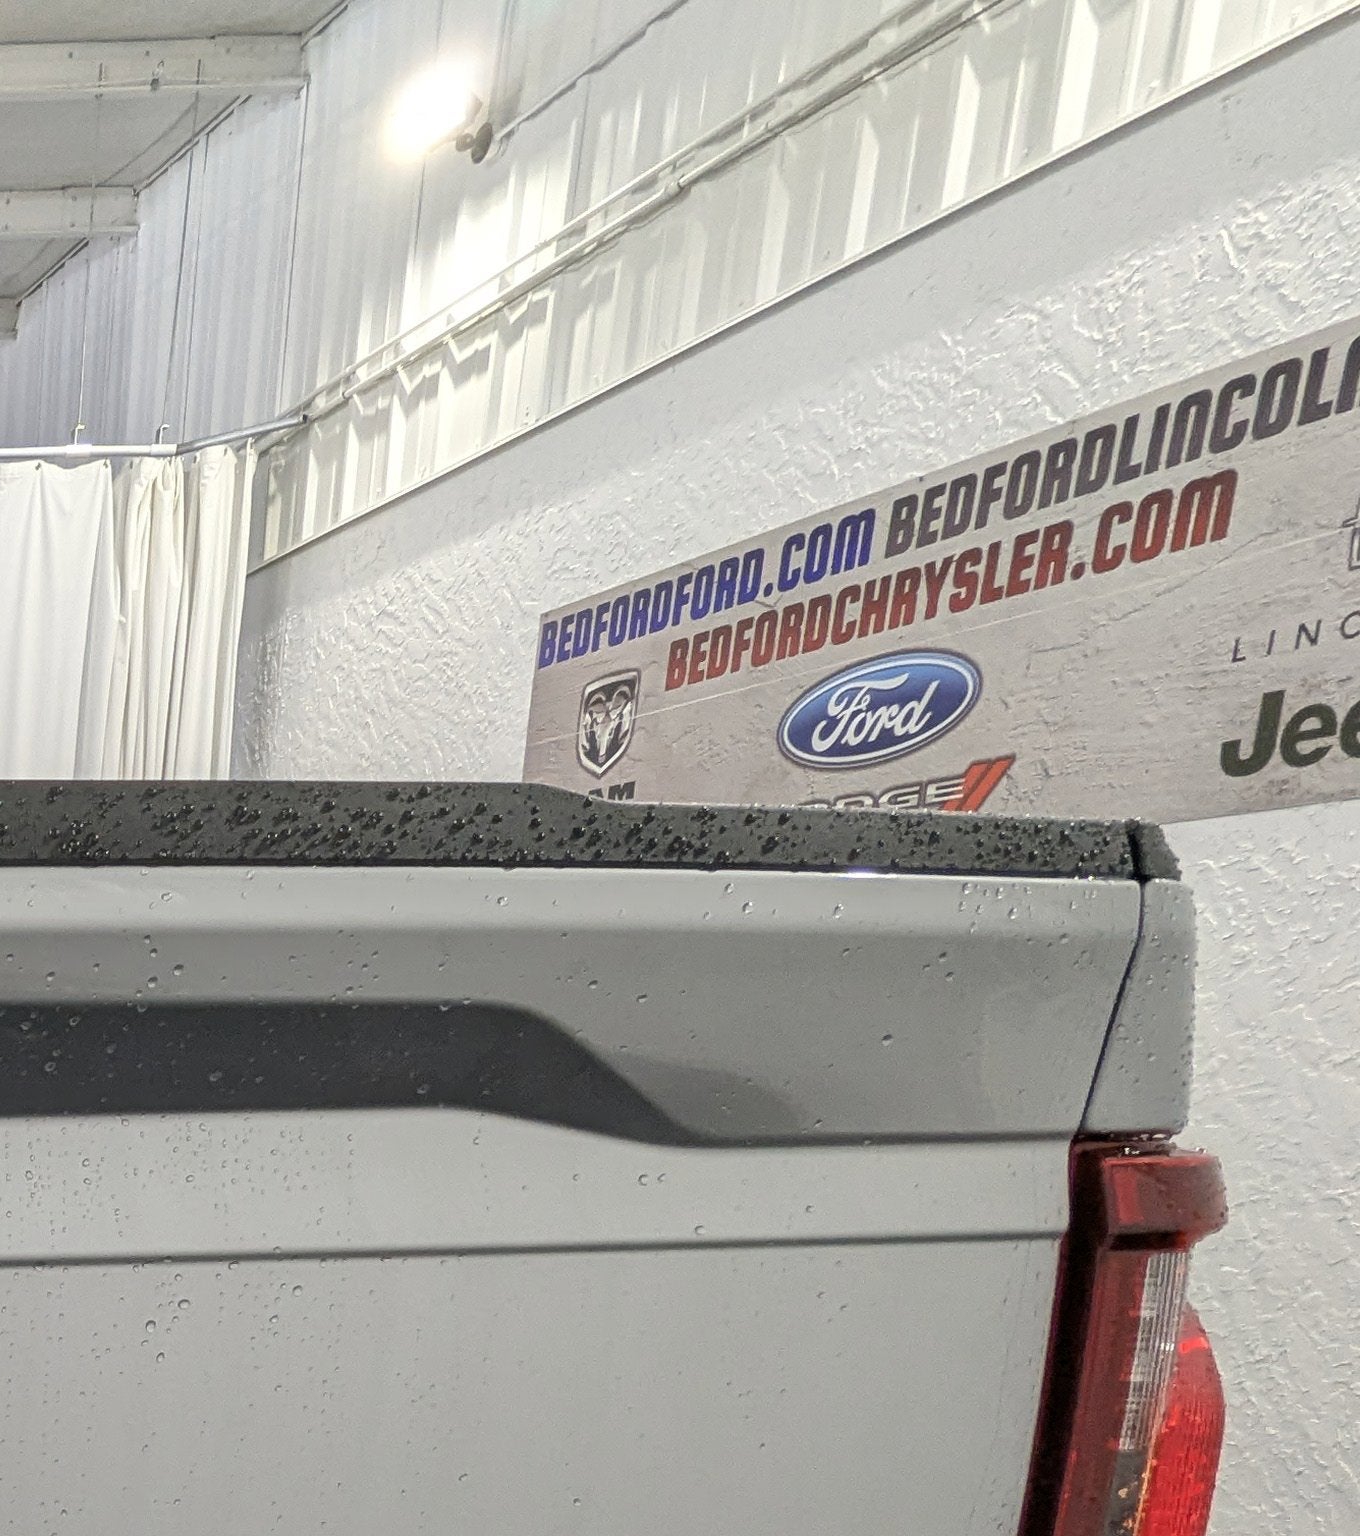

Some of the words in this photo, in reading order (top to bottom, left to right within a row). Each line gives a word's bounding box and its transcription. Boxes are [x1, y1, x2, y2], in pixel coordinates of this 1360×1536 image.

[538, 508, 876, 669] BEDFORDFORD.COM
[665, 469, 1238, 691] BEDFORDCHRYSLER.COM
[812, 672, 941, 754] Ford
